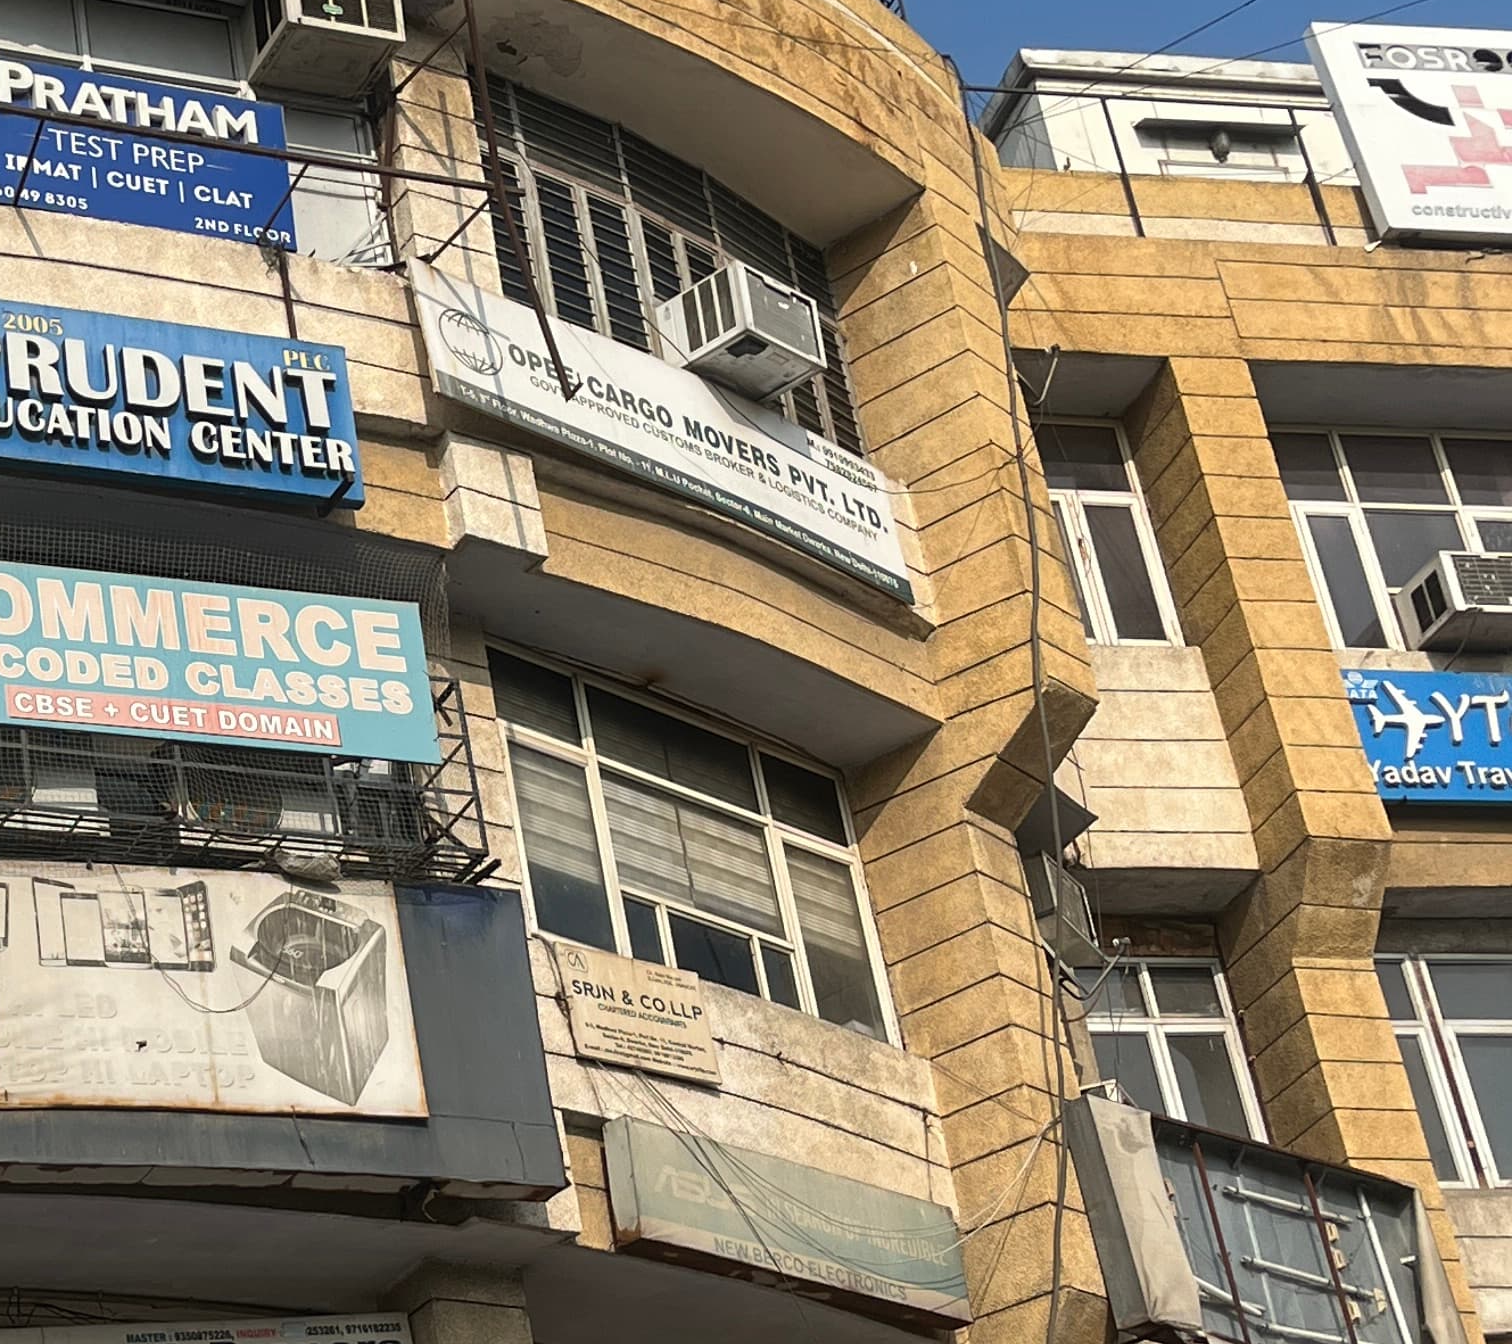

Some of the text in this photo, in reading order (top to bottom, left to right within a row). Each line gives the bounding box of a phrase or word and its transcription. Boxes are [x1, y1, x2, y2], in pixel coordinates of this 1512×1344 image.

[48, 128, 205, 173] TEST PREP
[44, 192, 88, 210] 8305
[106, 170, 169, 196] CUET
[193, 185, 253, 209] CLAT
[194, 217, 230, 233] 2ND
[2, 310, 64, 337] 2005
[282, 348, 331, 372] PEC
[191, 420, 356, 472] CENTER
[587, 376, 673, 428] CARGO
[683, 416, 780, 477] MOVERS
[788, 463, 836, 505] PVT.
[842, 492, 889, 534] LTD.
[572, 394, 639, 429] APPROVED
[643, 422, 701, 456] CUSTOMS
[704, 448, 755, 479] BROKER
[758, 472, 767, 484] &
[768, 478, 826, 514] LOGISTICS
[827, 507, 878, 541] COMPANY
[186, 661, 414, 716] CLASSES
[1348, 689, 1378, 699] ATA
[13, 692, 94, 719] CBSE
[129, 701, 207, 729] CUET
[219, 711, 334, 740] DOMAIN
[1368, 759, 1453, 784] Yadav
[572, 978, 615, 1002] SRJN
[622, 989, 634, 1006] &
[713, 1237, 908, 1301] NEW BERCO ELECTRONICS
